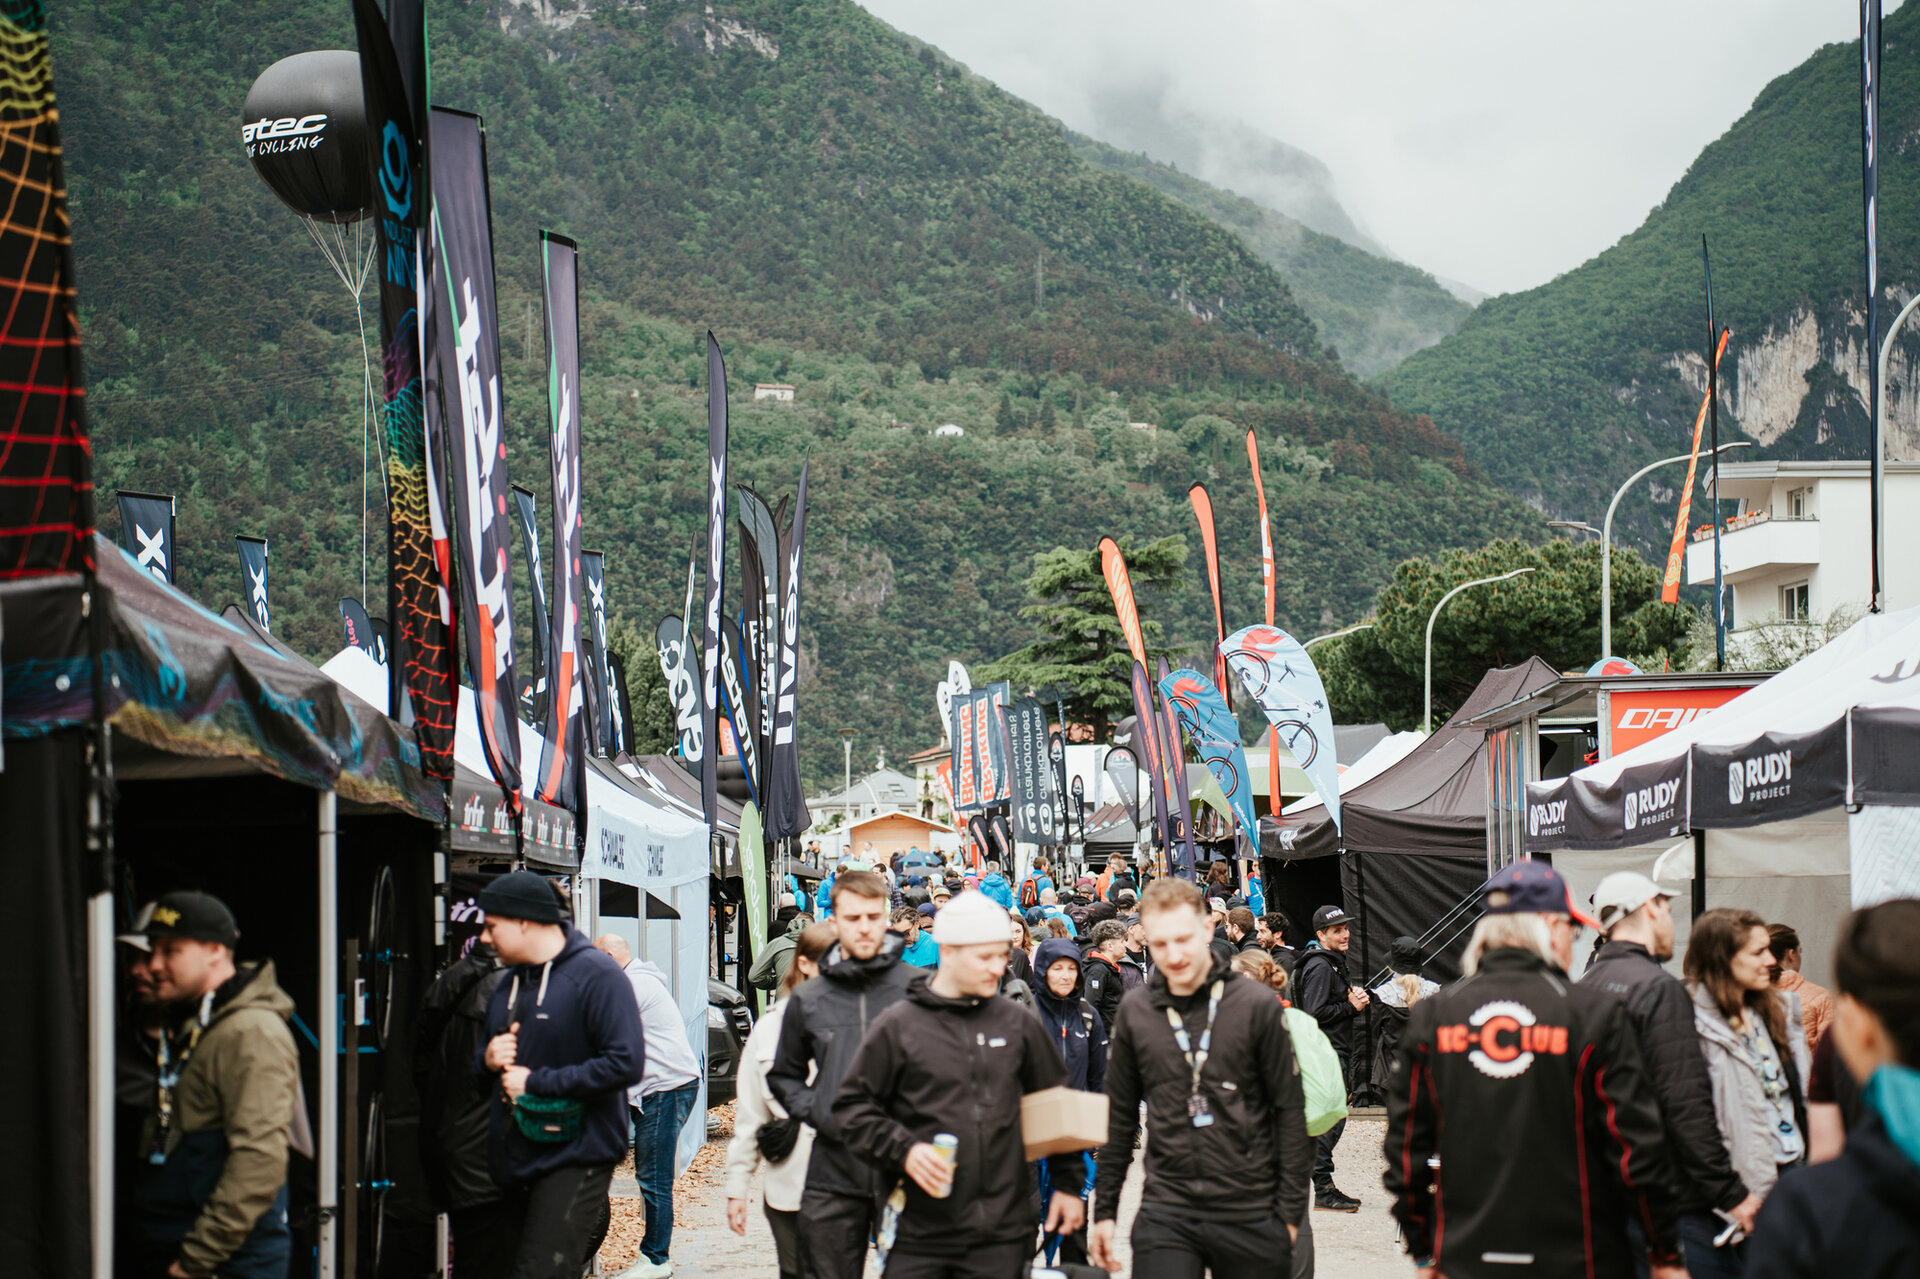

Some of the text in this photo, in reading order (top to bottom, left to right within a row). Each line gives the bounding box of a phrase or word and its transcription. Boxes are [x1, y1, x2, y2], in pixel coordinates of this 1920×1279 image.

[260, 135, 324, 156] CYCLING
[774, 544, 801, 746] uvex
[1746, 749, 1792, 789] RUDY
[1639, 778, 1680, 814] RUDY
[1750, 785, 1791, 802] PROJECT
[1538, 800, 1568, 826] RUDY
[1641, 808, 1675, 826] PROJECT
[1541, 825, 1566, 837] PROJECT
